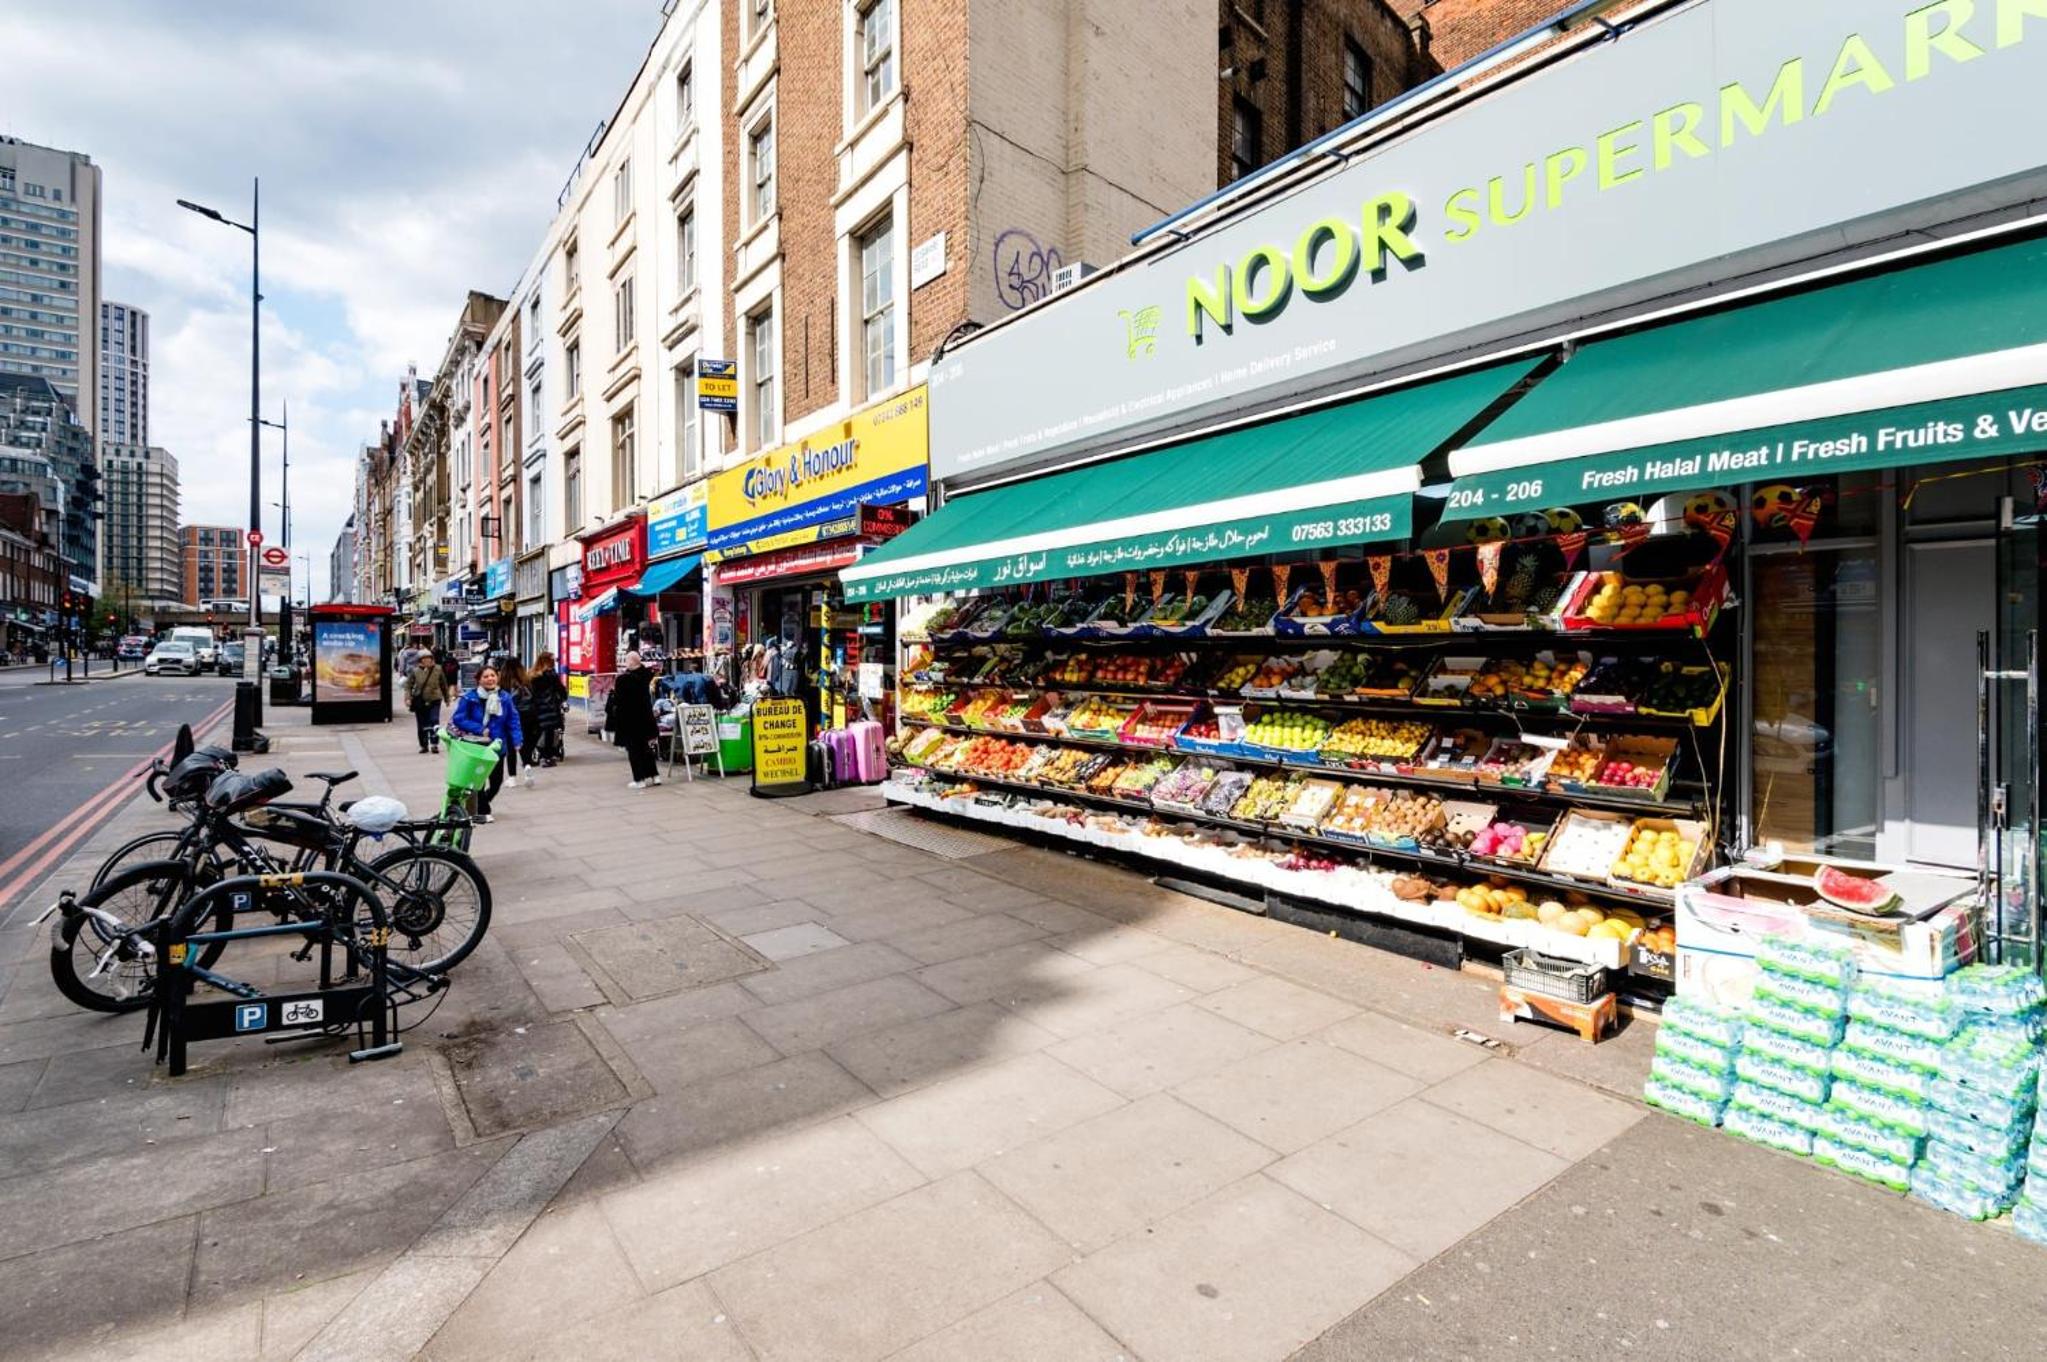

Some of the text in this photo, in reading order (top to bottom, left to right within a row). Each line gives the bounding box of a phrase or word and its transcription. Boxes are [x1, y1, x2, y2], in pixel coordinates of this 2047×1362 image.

[1184, 189, 1424, 344] NOOR
[1220, 366, 1248, 384] Home
[1250, 352, 1291, 375] Delivery
[1294, 338, 1337, 361] Service
[704, 382, 731, 392] TO LET
[1582, 467, 1639, 490] Fresh
[1643, 456, 1701, 481] Halal
[1707, 446, 1770, 472] Meat
[1791, 431, 1869, 462] Fresh
[1876, 418, 1964, 450] Fruits
[1973, 414, 2000, 439] &
[2008, 407, 2047, 435] Ve
[755, 466, 786, 497] Glory
[790, 453, 799, 484] &
[803, 438, 855, 480] Honour
[1450, 486, 1485, 509] 204
[1506, 479, 1543, 503] 206
[877, 508, 894, 520] 0%
[1291, 512, 1392, 543] 07563 333133
[1192, 532, 1217, 552] طازجة
[1219, 528, 1245, 549] حلال
[1245, 525, 1269, 550] لحوم
[992, 559, 1012, 582] نور
[757, 704, 803, 717] BUREAU DE
[763, 719, 797, 730] CHANGE
[764, 757, 797, 768] CAMBIO
[762, 768, 800, 779] WECHSEL
[243, 1006, 262, 1028] P
[1879, 1009, 1918, 1025] AVANT
[1768, 1039, 1801, 1054] AVANT
[1873, 1037, 1911, 1054] AVANT
[1760, 1068, 1794, 1085] AVANT
[1760, 1098, 1793, 1114] AVANT
[1750, 1124, 1784, 1140] AVANT
[1843, 1126, 1880, 1144] AVANT
[1841, 1151, 1880, 1169] AVANT
